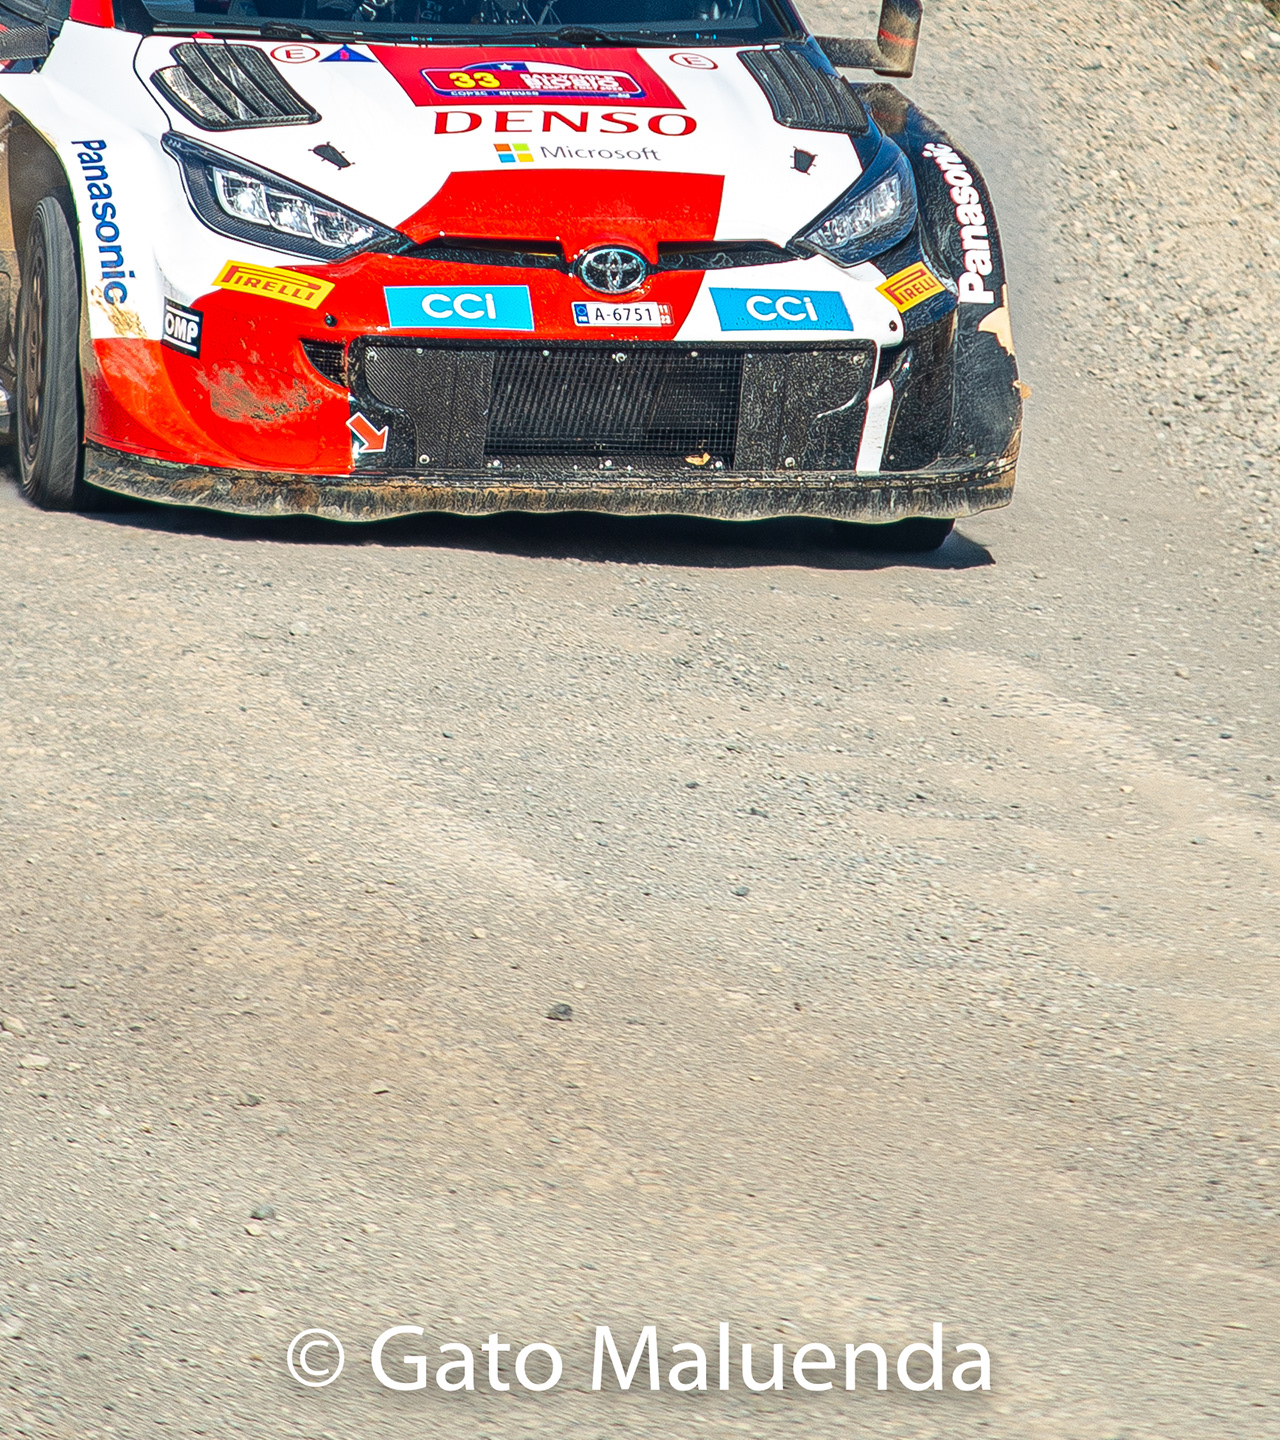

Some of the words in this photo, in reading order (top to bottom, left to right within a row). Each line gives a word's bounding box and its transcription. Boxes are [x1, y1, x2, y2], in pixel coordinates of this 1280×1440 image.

[448, 71, 501, 89] 33
[434, 110, 698, 137] DENSO
[540, 146, 662, 162] Microsoft
[71, 139, 136, 305] Panasonic
[922, 142, 996, 304] Panasonic
[222, 265, 321, 302] PIRELLI
[884, 268, 937, 306] PIRELLI
[164, 311, 199, 344] OMP
[595, 307, 652, 322] A-6751
